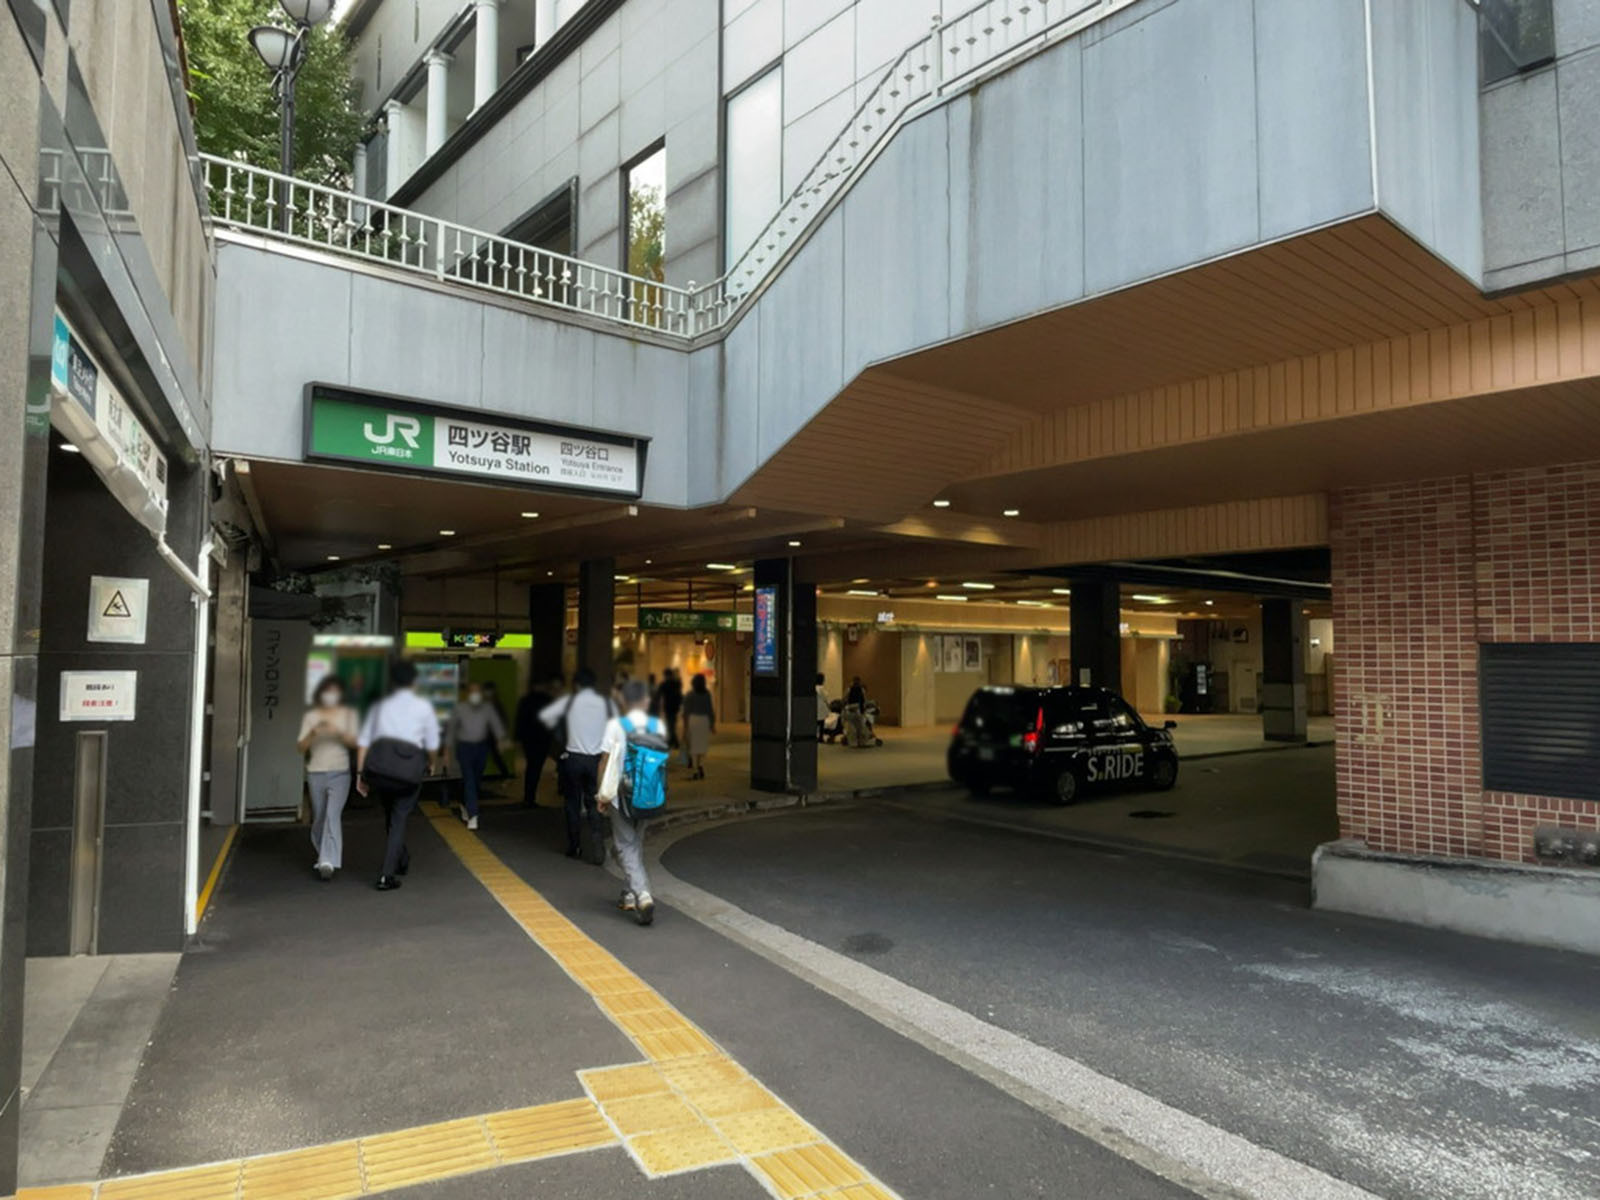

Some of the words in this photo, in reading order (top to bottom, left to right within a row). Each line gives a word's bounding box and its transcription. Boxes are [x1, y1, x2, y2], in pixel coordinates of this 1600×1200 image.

[363, 413, 421, 449] JR
[448, 425, 532, 457] 四ツ谷駅
[448, 450, 502, 470] Yotsuya
[505, 457, 550, 475] Station
[560, 441, 609, 461] 四ツ谷口
[453, 633, 490, 645] KIOSK
[264, 629, 280, 720] コインロッカー
[1087, 752, 1144, 782] S.RIDE
